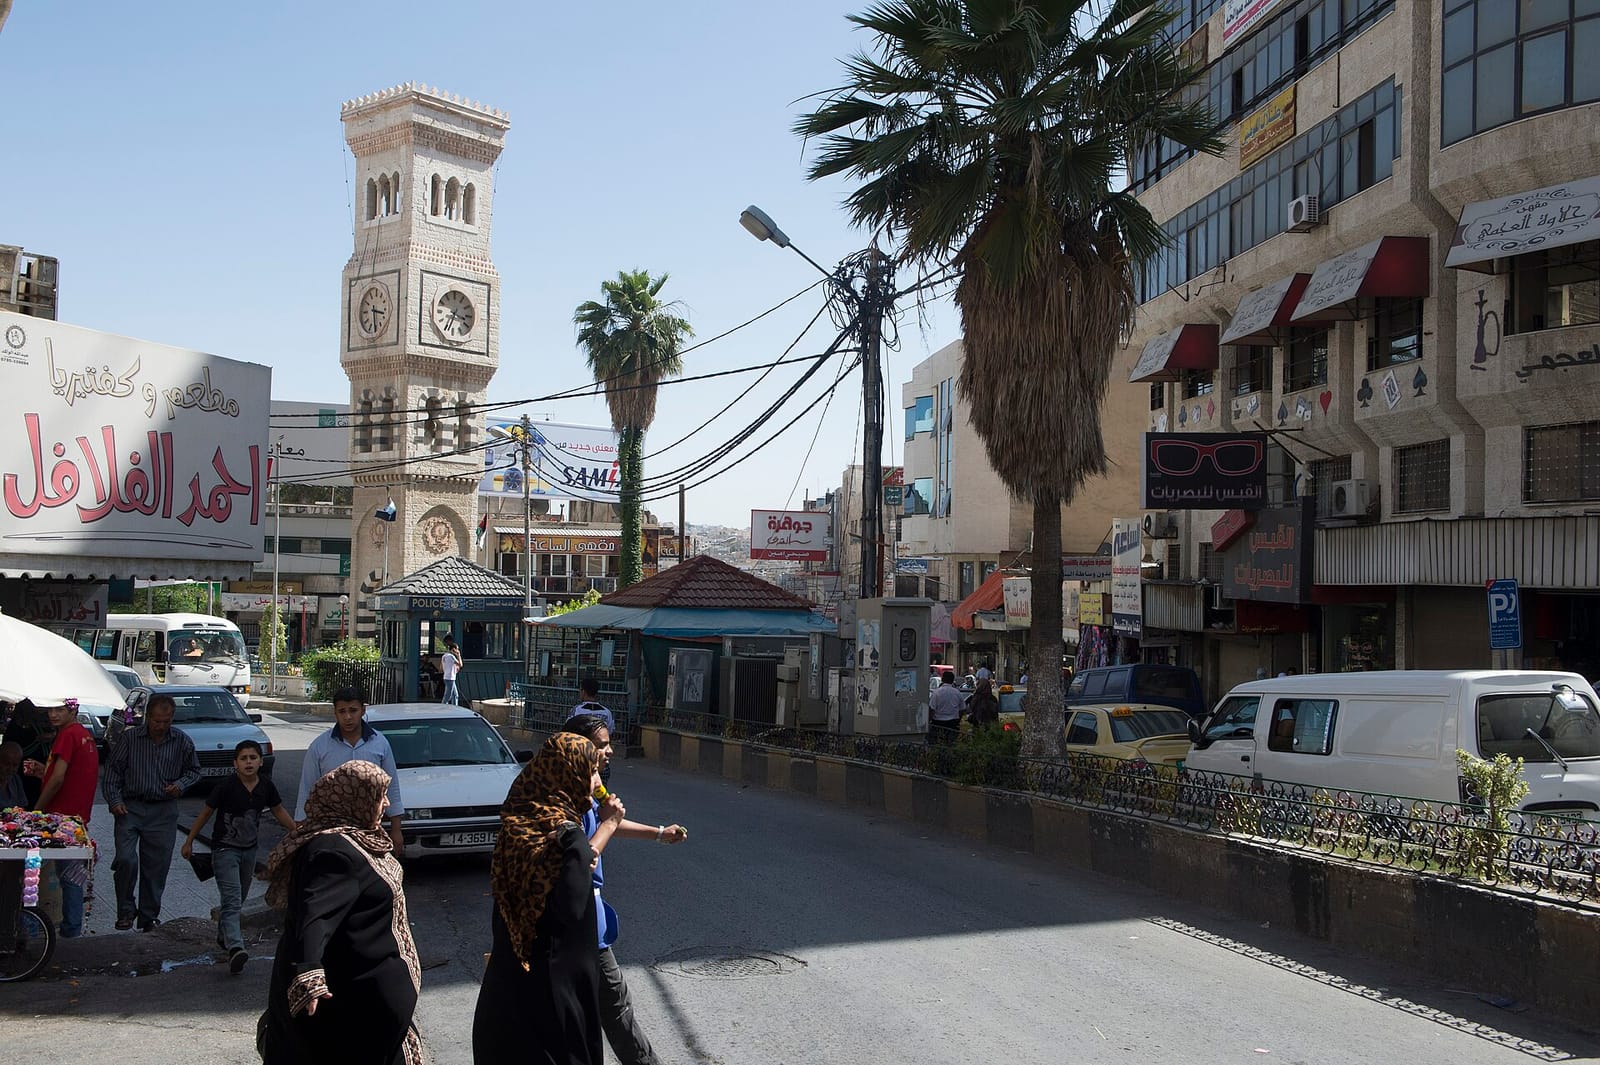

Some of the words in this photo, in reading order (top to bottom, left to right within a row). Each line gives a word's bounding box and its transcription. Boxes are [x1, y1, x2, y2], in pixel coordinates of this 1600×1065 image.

[1516, 201, 1548, 214] مقهى
[45, 336, 142, 407] كفتيريا
[142, 382, 158, 418] و
[162, 366, 240, 420] مطعم
[568, 442, 591, 452] جديد
[2, 412, 174, 525] الفلافل
[176, 445, 260, 527] احمد
[1150, 485, 1213, 502] للبصريات
[1215, 484, 1262, 502] القبس
[768, 516, 812, 533] جوهرة
[1249, 523, 1295, 553] القبس
[574, 539, 615, 552] مقهى
[1233, 561, 1294, 593] للبصريات
[412, 599, 445, 608] POLICE
[1490, 594, 1509, 624] P
